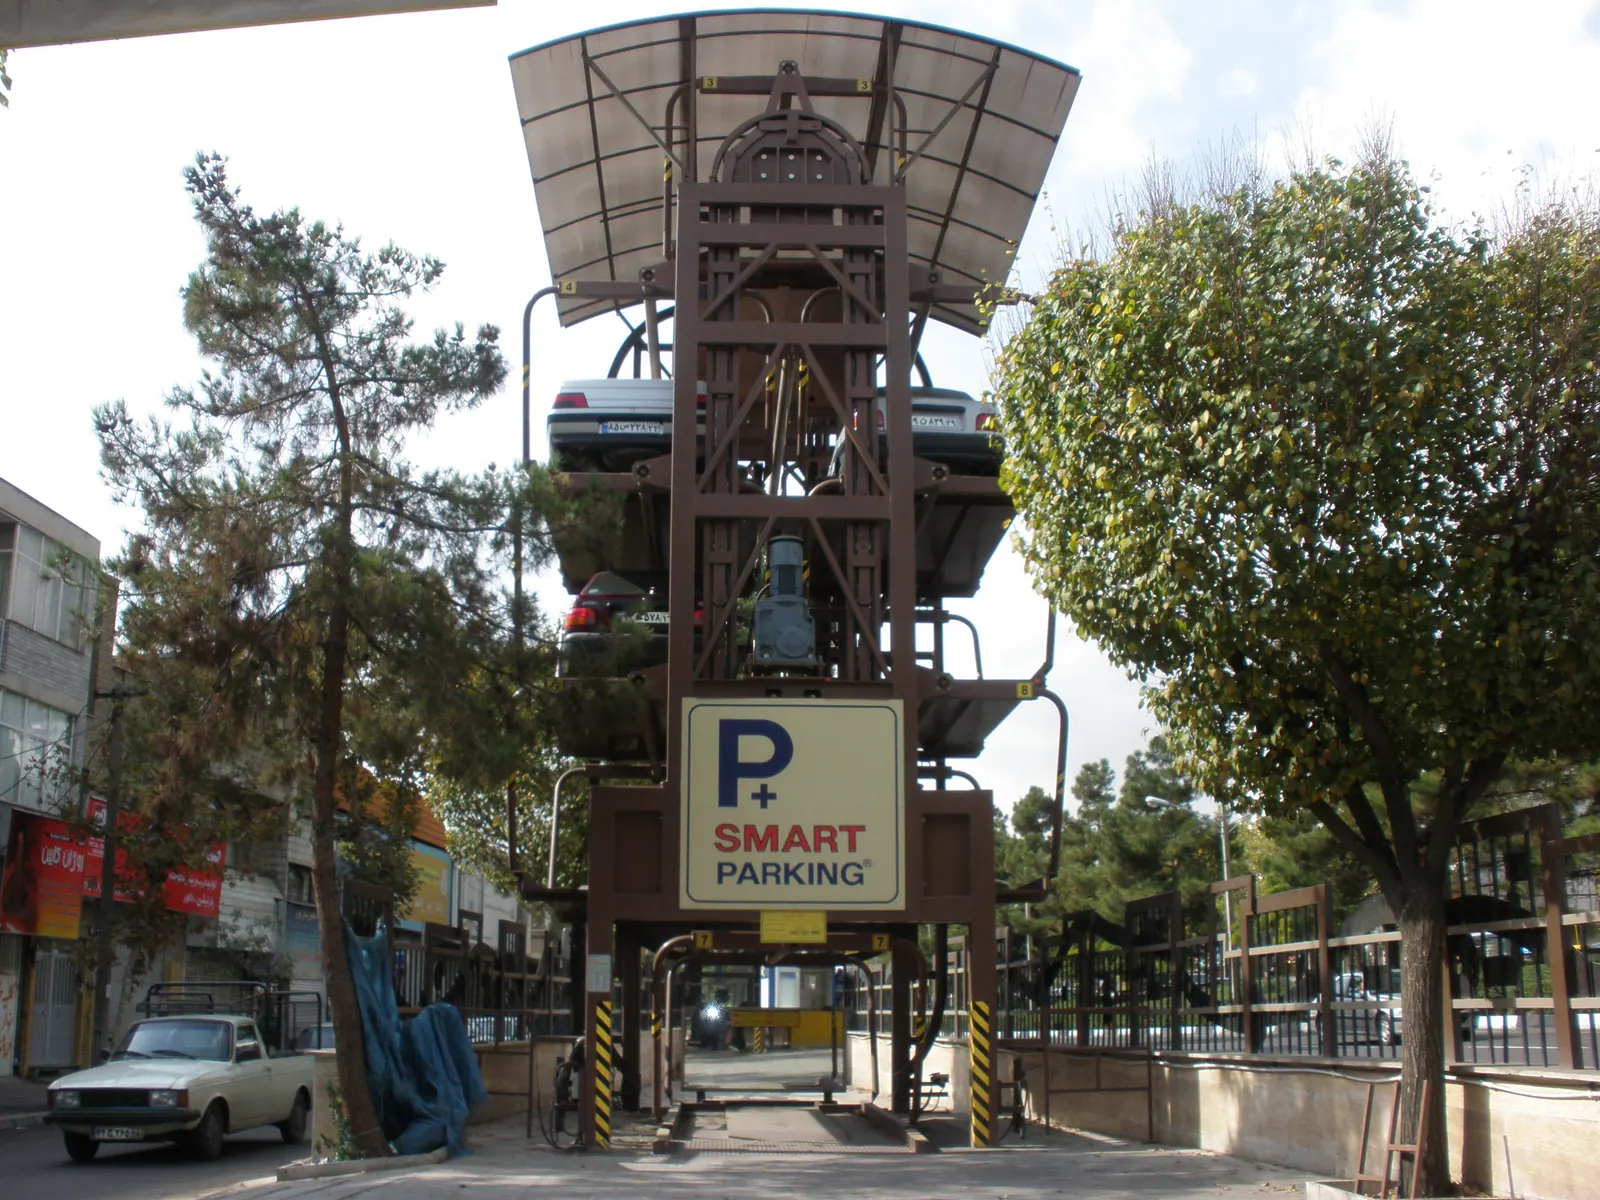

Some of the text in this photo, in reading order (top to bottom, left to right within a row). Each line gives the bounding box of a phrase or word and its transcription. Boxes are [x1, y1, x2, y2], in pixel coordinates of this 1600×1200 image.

[707, 78, 714, 87] 3
[861, 81, 868, 90] 3
[565, 282, 573, 292] 4
[1020, 684, 1029, 696] 8
[714, 823, 866, 853] SMART
[701, 935, 709, 945] 7
[877, 936, 885, 948] 7
